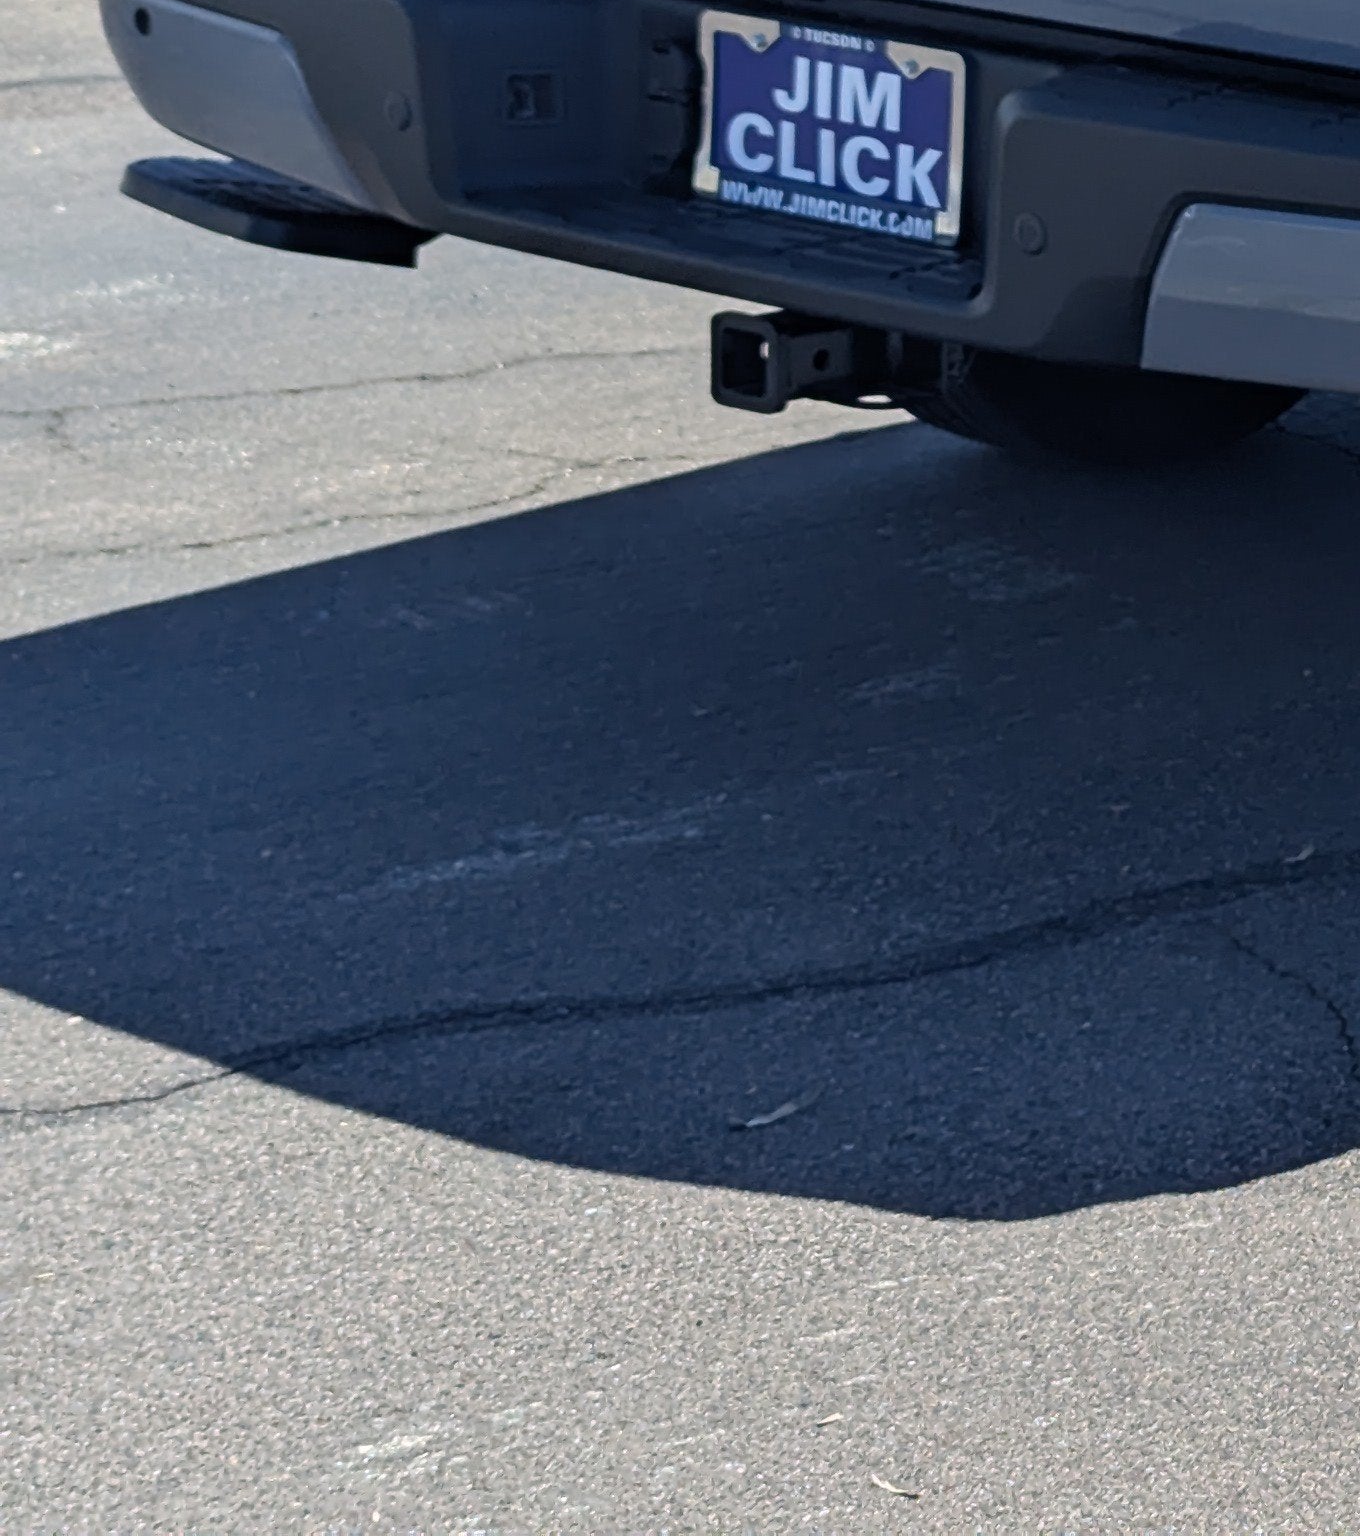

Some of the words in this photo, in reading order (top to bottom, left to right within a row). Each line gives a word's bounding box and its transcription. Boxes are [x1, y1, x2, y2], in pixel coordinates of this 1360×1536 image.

[803, 26, 862, 50] TUCSON
[772, 55, 902, 133] JIM
[726, 112, 943, 208] CLICK
[721, 179, 935, 241] WWW.JIMCLICK.COM
